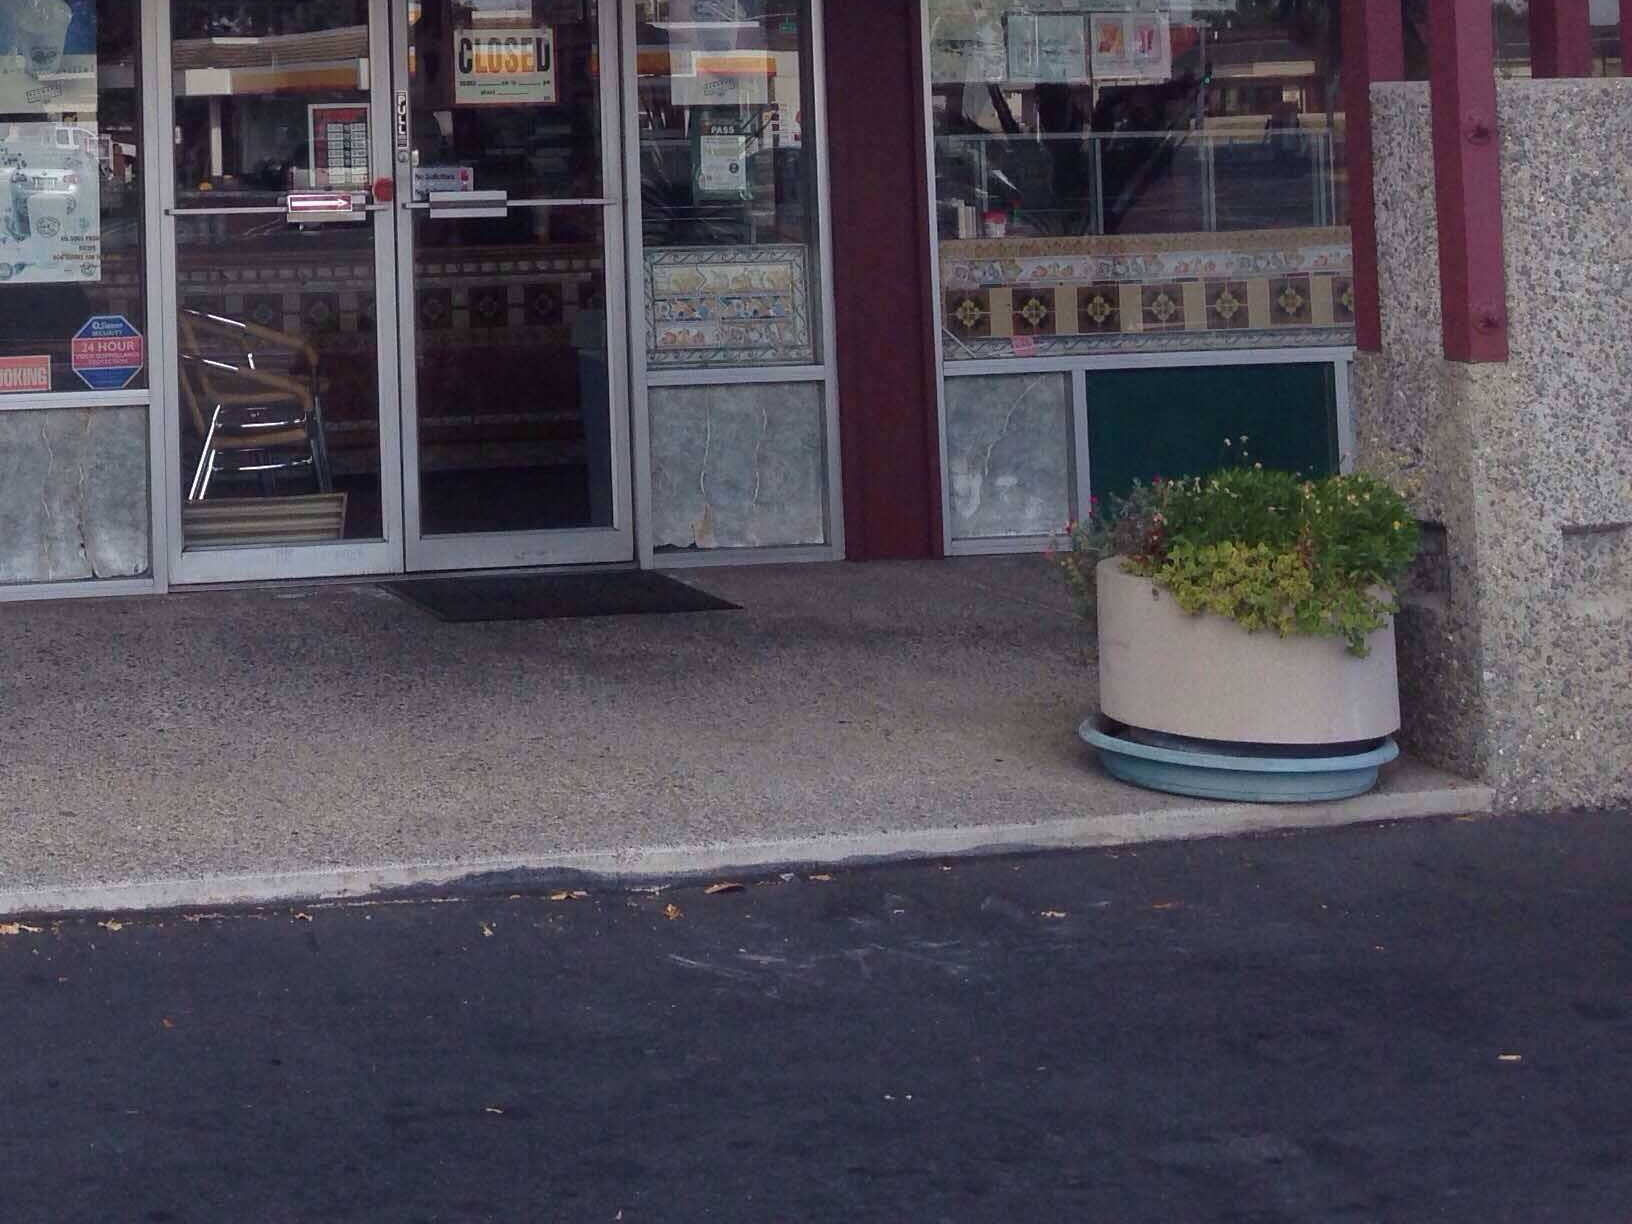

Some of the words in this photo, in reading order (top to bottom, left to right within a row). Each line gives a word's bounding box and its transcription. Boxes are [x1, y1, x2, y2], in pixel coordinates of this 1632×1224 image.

[458, 37, 551, 74] CLOSED
[397, 95, 407, 135] PULL
[711, 125, 735, 134] PASS
[80, 342, 95, 353] 24
[97, 340, 136, 352] HOUR
